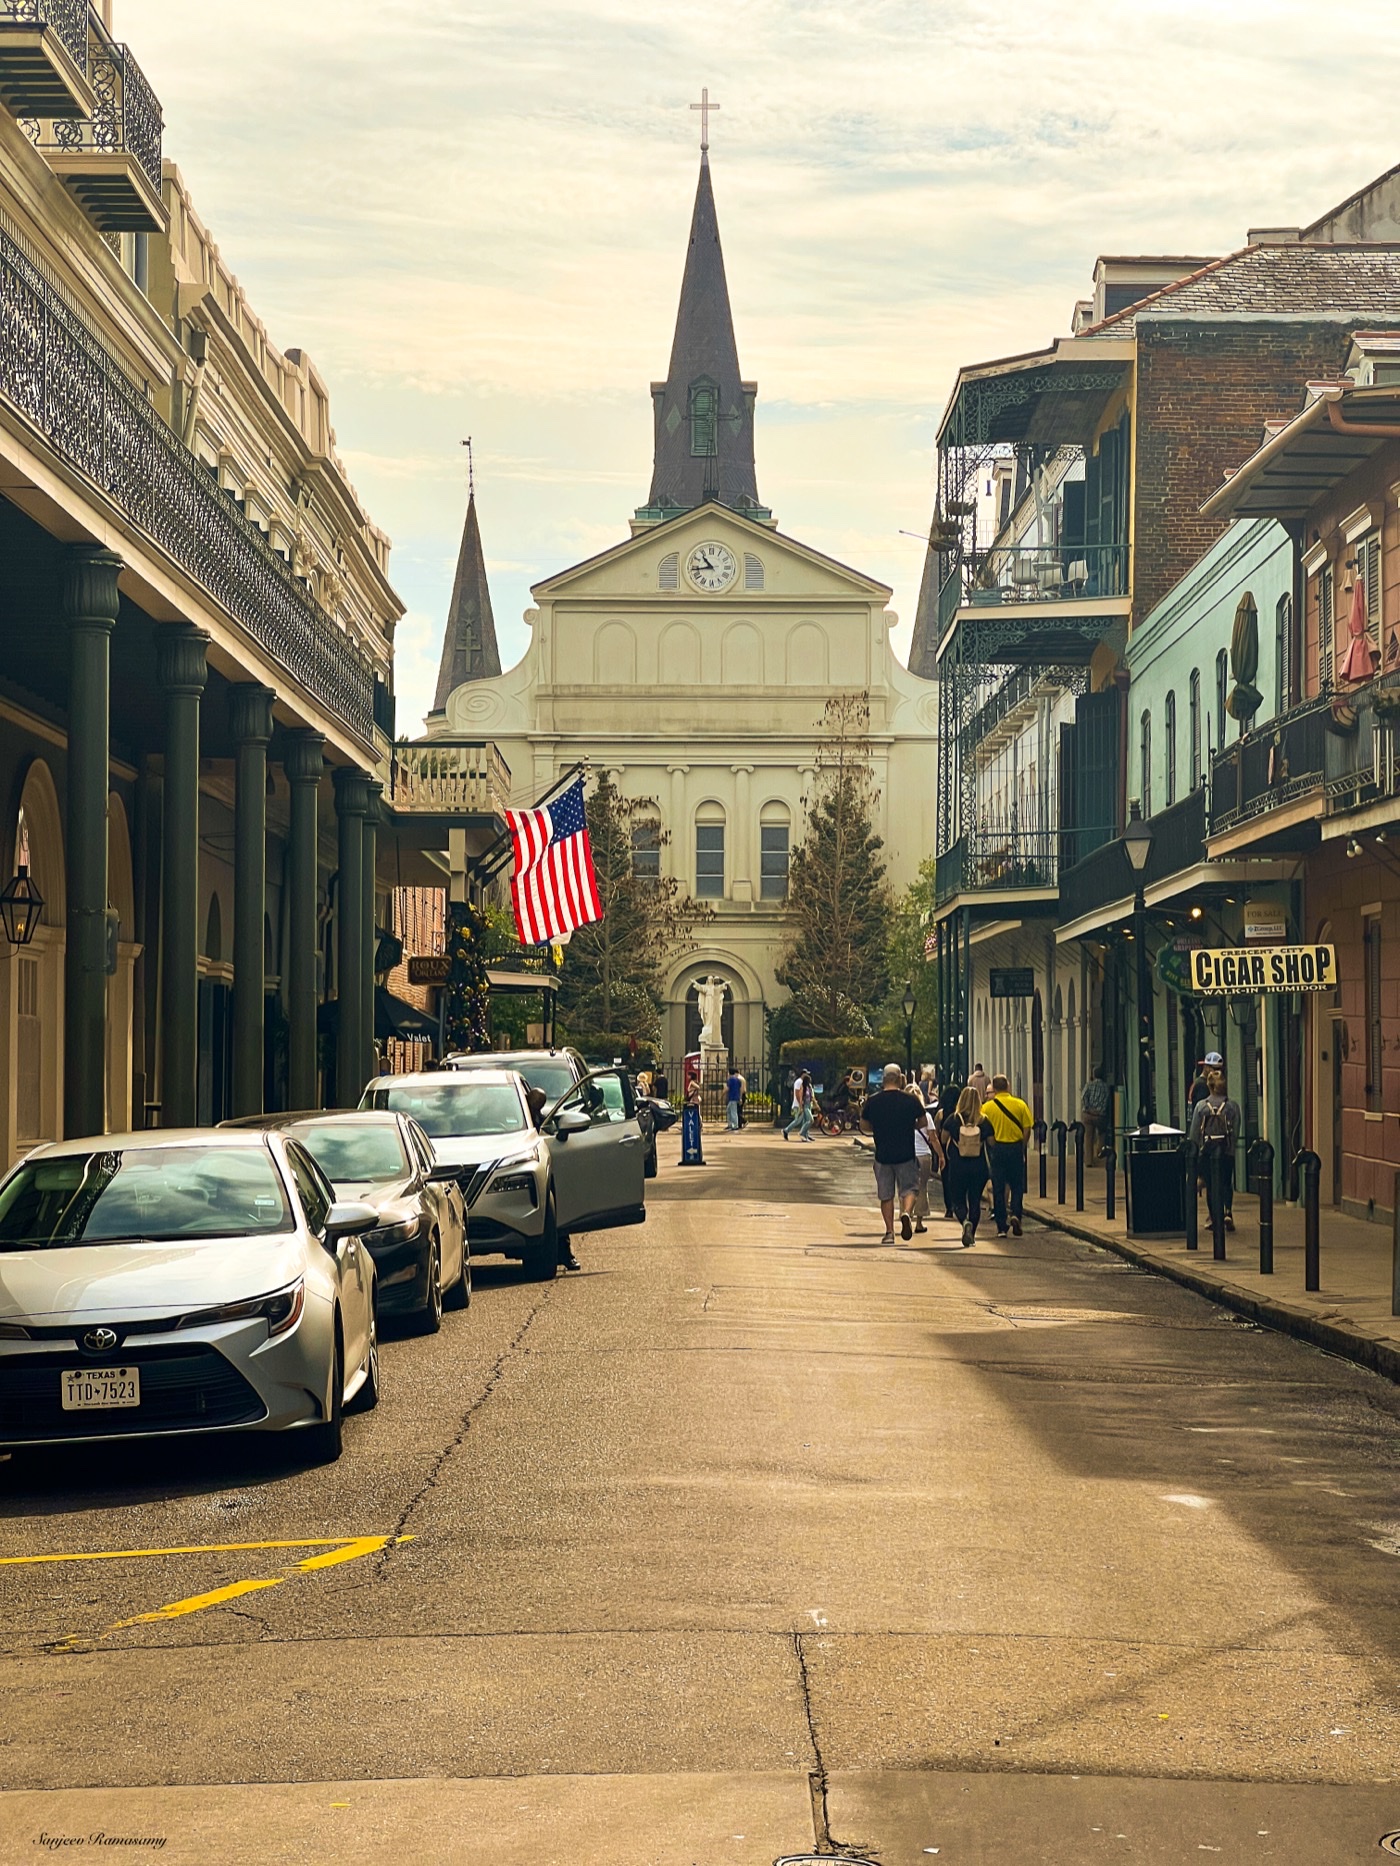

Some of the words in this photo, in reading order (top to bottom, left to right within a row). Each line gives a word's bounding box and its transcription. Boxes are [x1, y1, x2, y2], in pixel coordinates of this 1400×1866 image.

[1220, 948, 1274, 956] CRESCENT
[411, 960, 449, 970] ROUX
[1196, 951, 1265, 988] CIGAR
[1271, 946, 1331, 985] SHOP
[1203, 987, 1259, 996] WALK-IN
[1267, 984, 1327, 993] HUMIDOR
[406, 1033, 432, 1042] Valet
[86, 1371, 116, 1380] TEXAS
